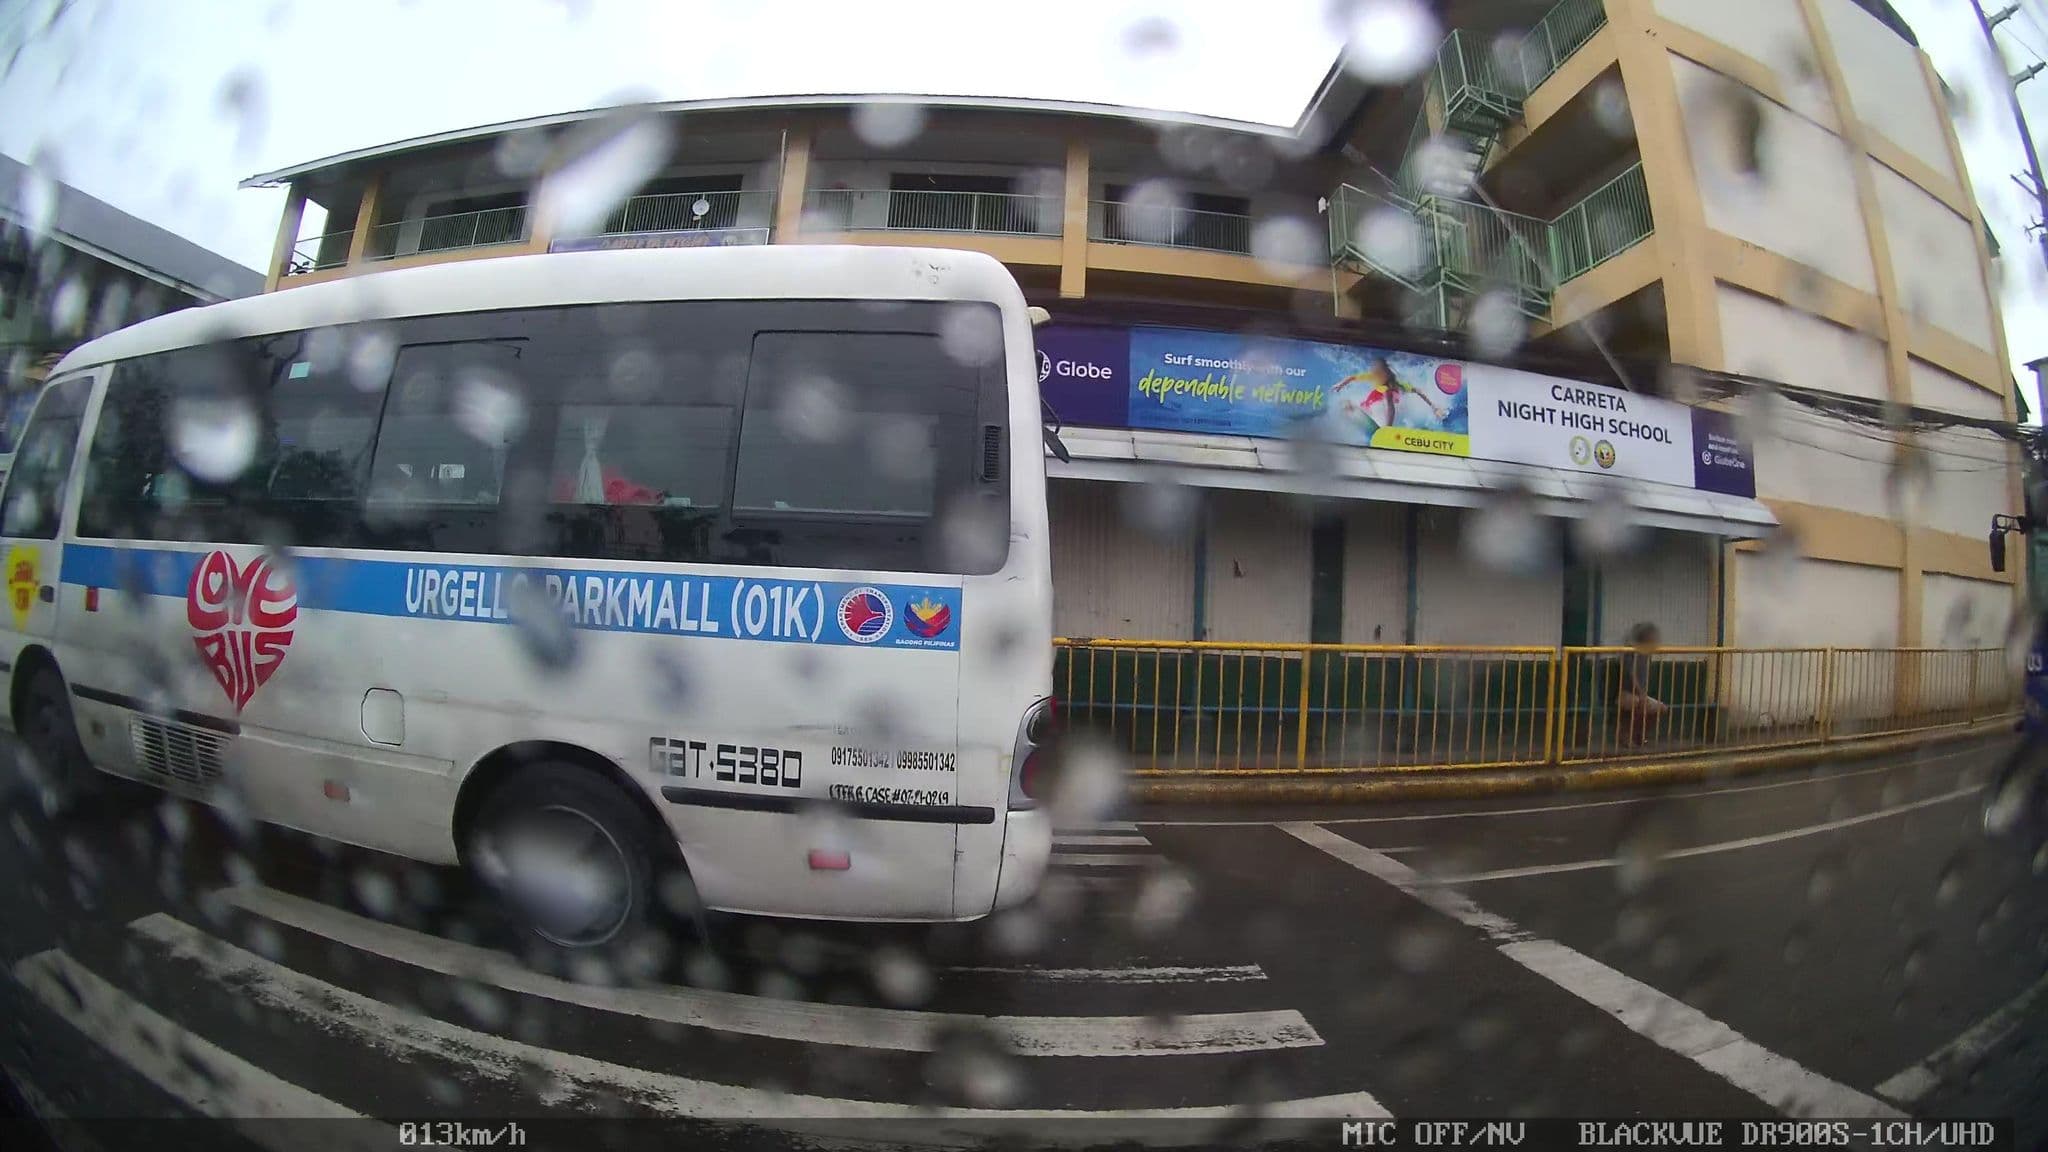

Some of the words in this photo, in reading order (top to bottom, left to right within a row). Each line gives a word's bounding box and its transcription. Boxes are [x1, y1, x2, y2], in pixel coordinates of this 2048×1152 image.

[1056, 360, 1113, 379] Globe
[1164, 353, 1193, 366] Surf
[1285, 367, 1306, 377] our
[1138, 368, 1245, 404] dependable
[1252, 380, 1324, 410] network
[1551, 384, 1627, 413] CARRETA
[1498, 400, 1556, 425] NIGHT
[1561, 410, 1604, 433] HIGH
[1609, 418, 1672, 444] SCHOOL
[1404, 437, 1430, 448] CEBU
[1433, 440, 1454, 451] CITY
[187, 550, 298, 631] LOVE
[546, 574, 719, 632] PARKMALL
[193, 630, 294, 715] BUS
[896, 751, 955, 771] 09985501342
